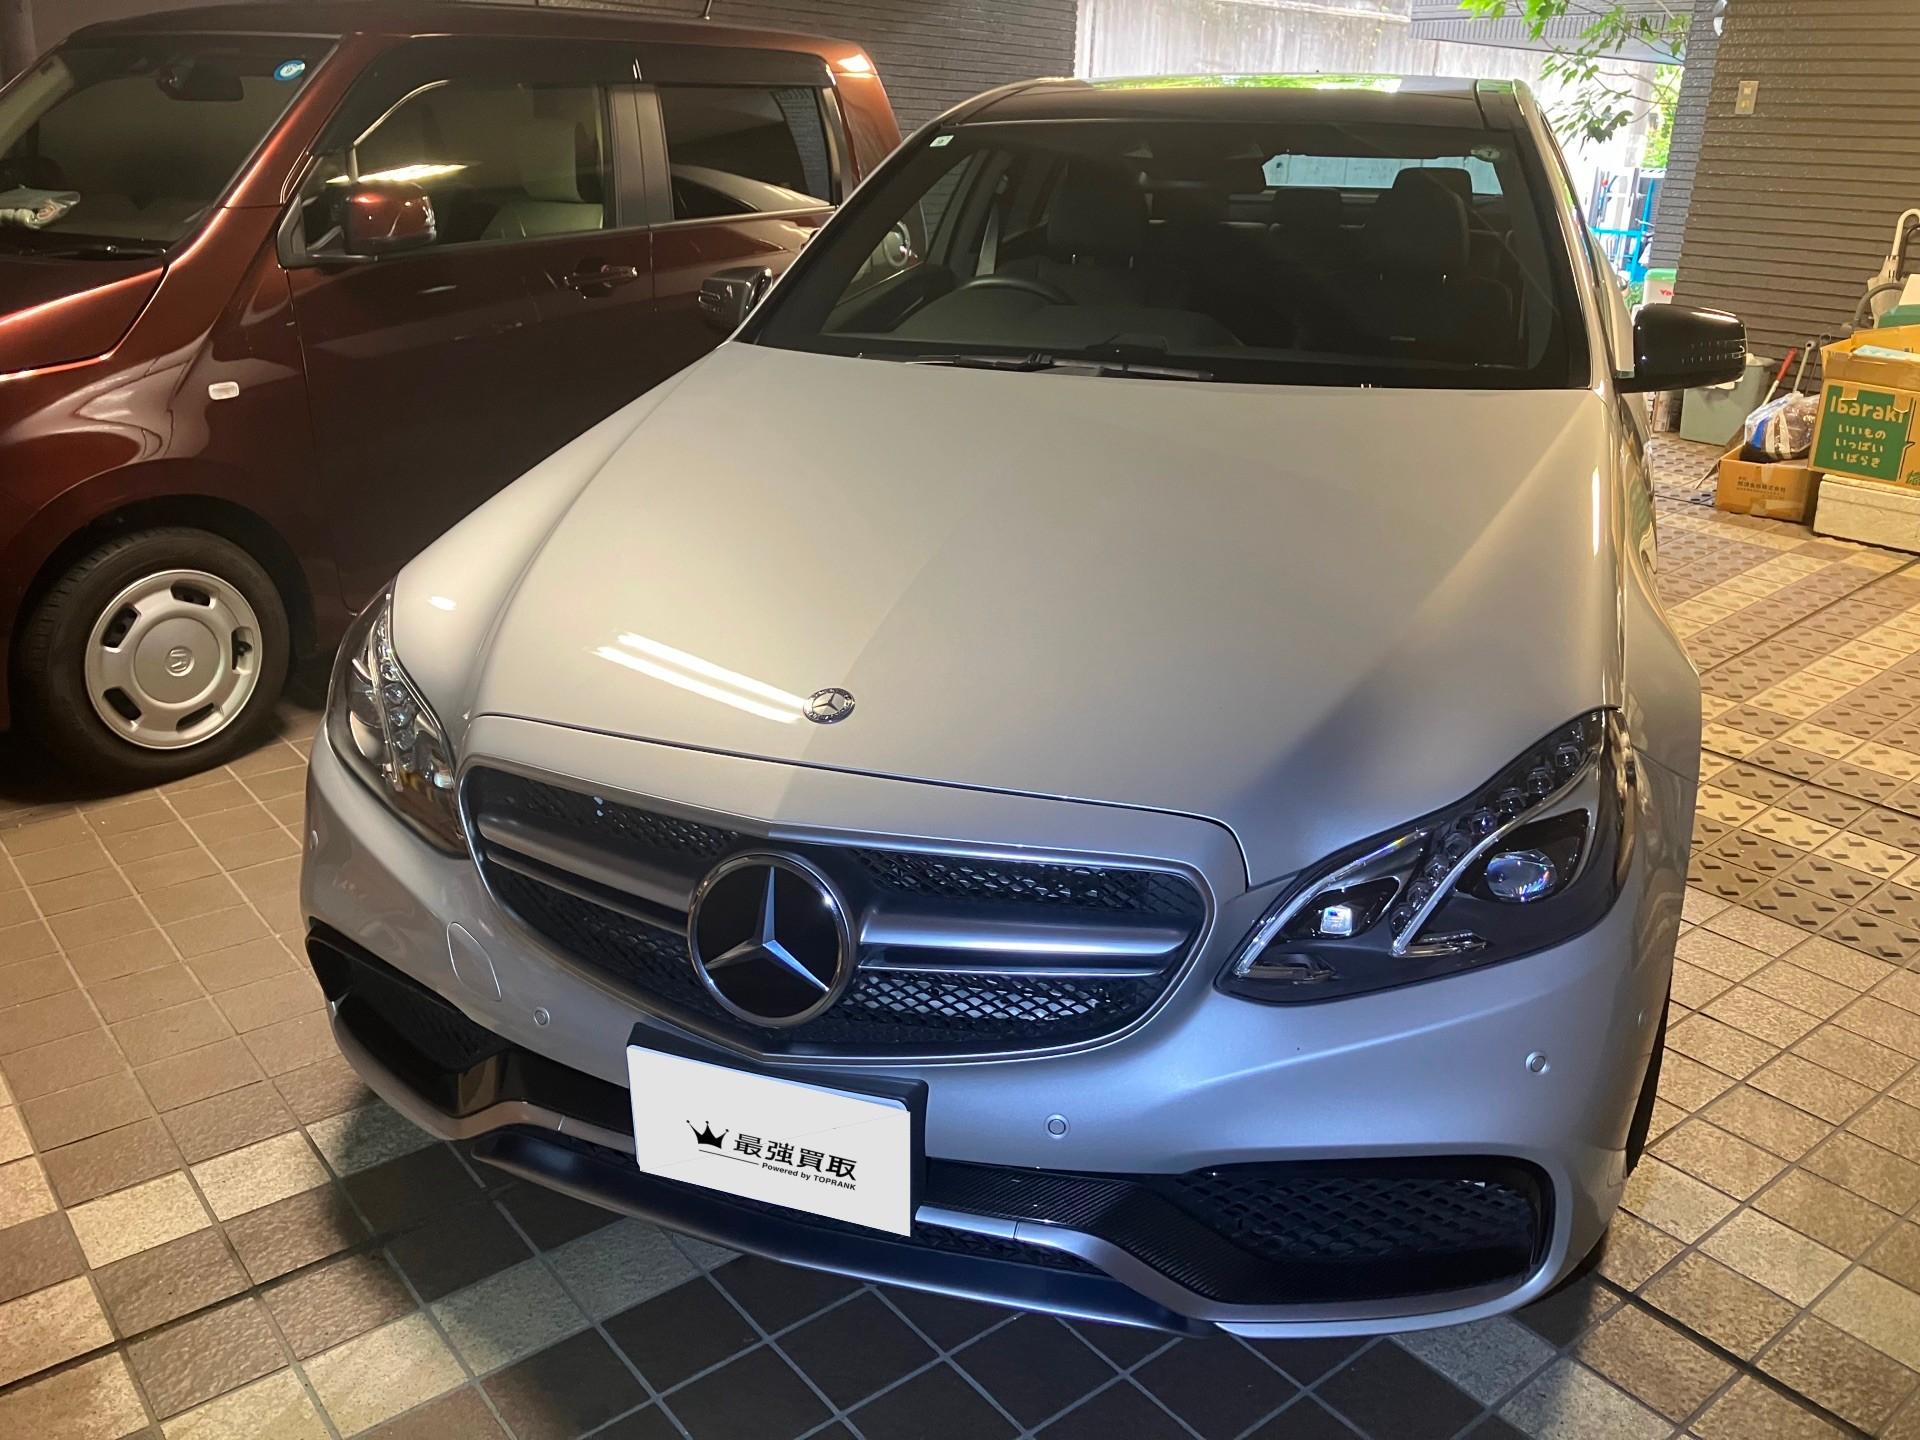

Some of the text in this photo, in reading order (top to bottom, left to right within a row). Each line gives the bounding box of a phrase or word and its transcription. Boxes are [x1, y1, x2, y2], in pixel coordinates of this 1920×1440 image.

[1830, 395, 1904, 424] Ibaraki
[1838, 424, 1886, 440] いいもの
[1832, 451, 1881, 468] いばらき
